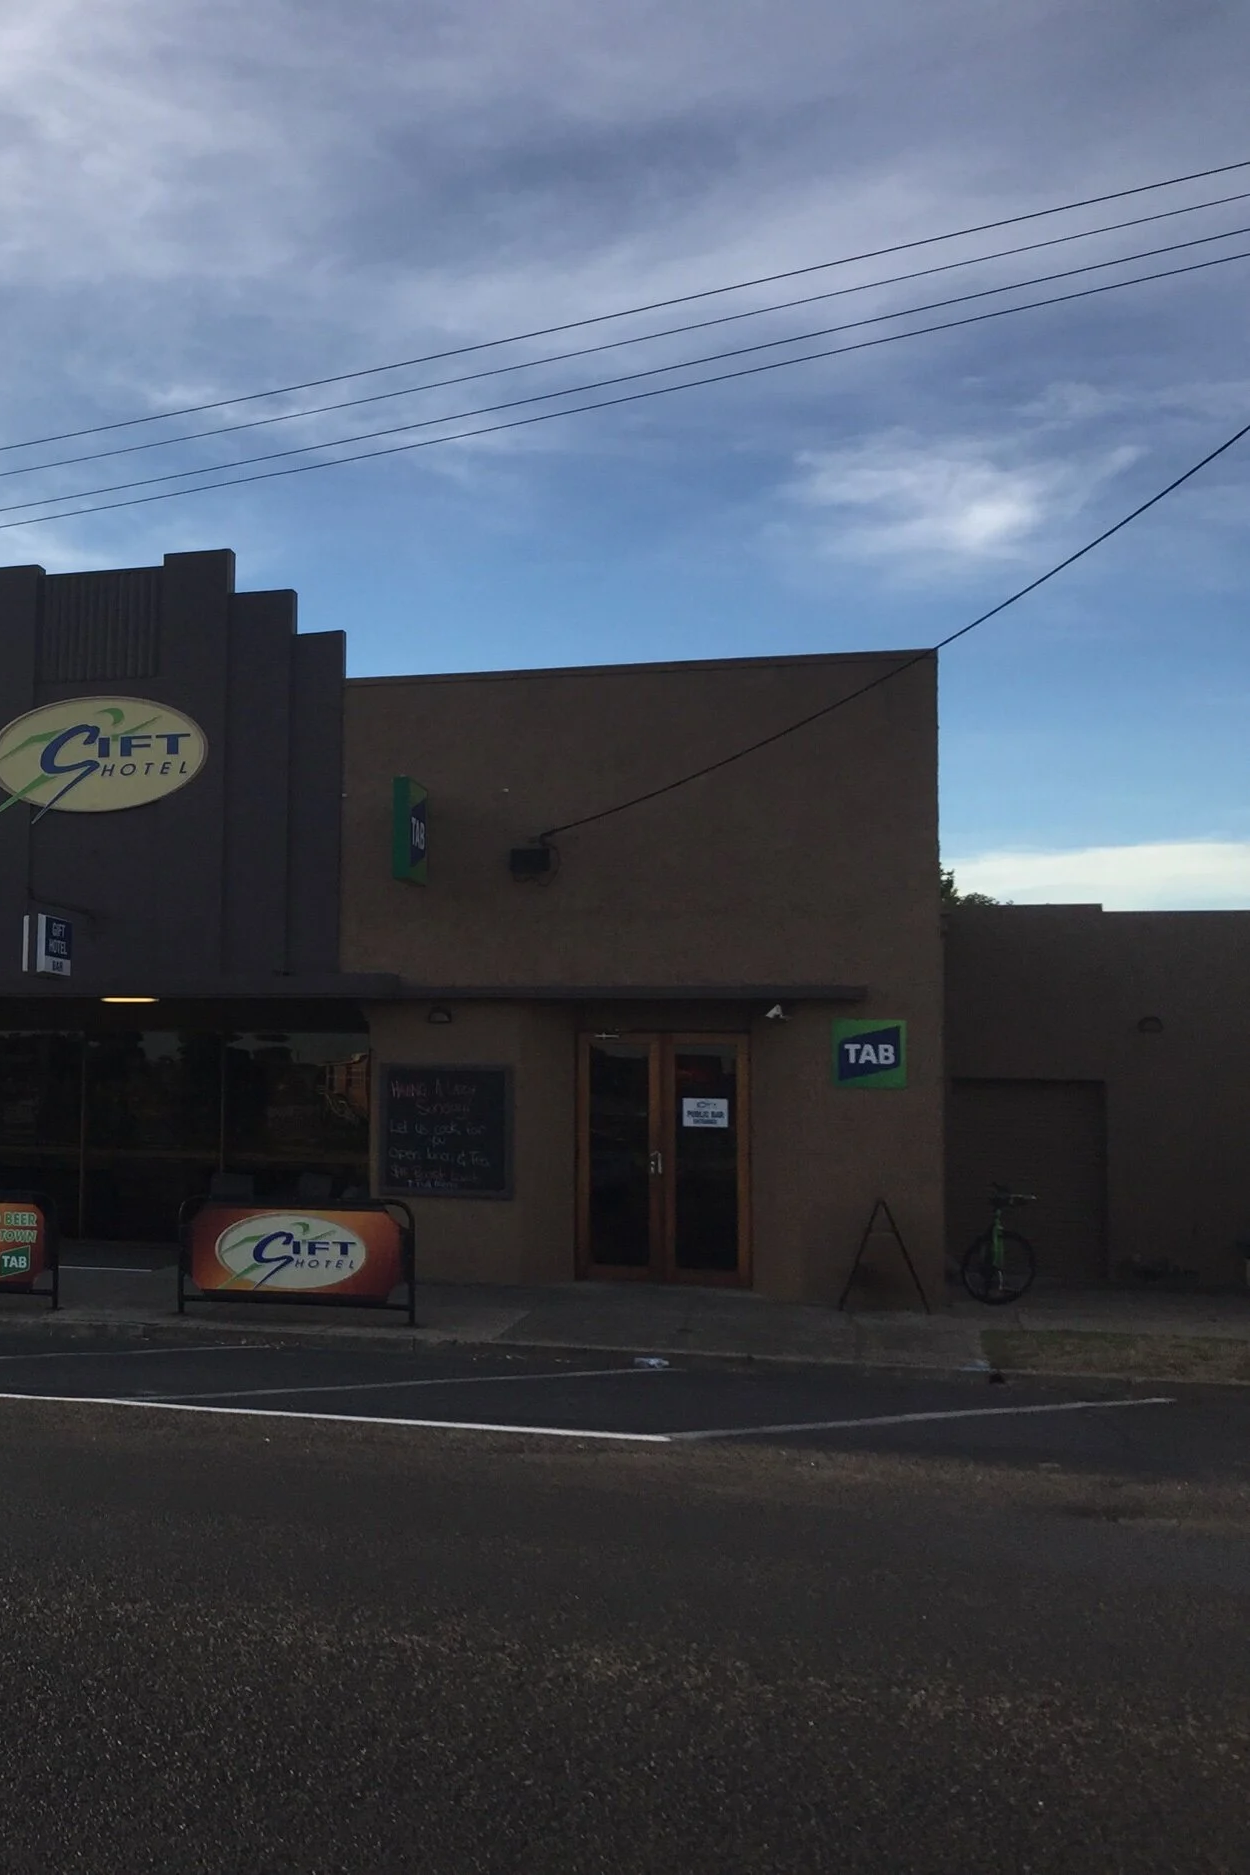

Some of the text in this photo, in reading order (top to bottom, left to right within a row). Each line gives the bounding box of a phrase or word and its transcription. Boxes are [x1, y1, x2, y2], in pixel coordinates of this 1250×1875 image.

[101, 761, 188, 777] HOTEL
[411, 816, 425, 850] TAB
[52, 922, 66, 938] GIFT
[49, 939, 68, 955] HOTEL
[844, 1043, 896, 1065] TAB
[4, 1212, 38, 1226] BEER
[0, 1229, 38, 1243] TOWN
[1, 1256, 28, 1269] TAB
[253, 1231, 356, 1291] GIFT
[295, 1259, 354, 1269] HOTEL
